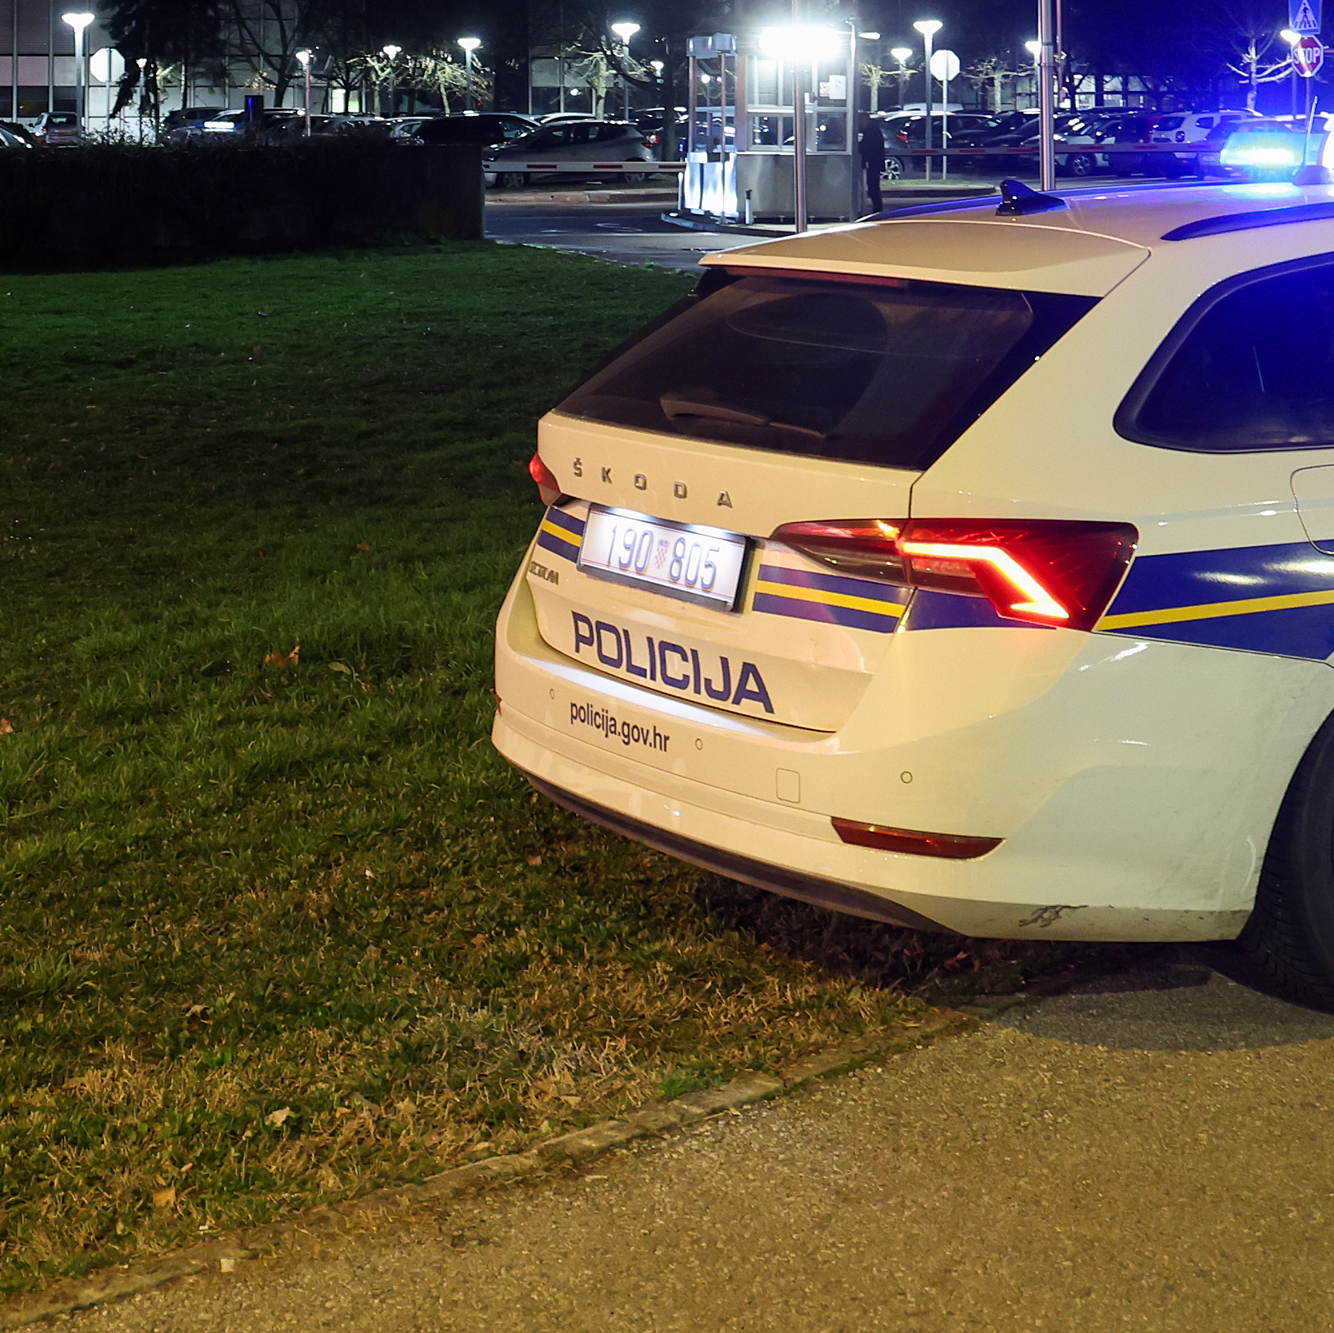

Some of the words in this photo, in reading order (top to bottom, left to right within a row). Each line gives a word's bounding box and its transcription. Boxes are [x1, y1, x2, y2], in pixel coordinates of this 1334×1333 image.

[1294, 47, 1320, 64] STOP
[573, 457, 733, 509] ŠKODA
[607, 523, 654, 572] 190
[669, 536, 720, 590] 805
[571, 610, 776, 715] POLICIJA
[570, 701, 670, 753] policija.gov.hr
